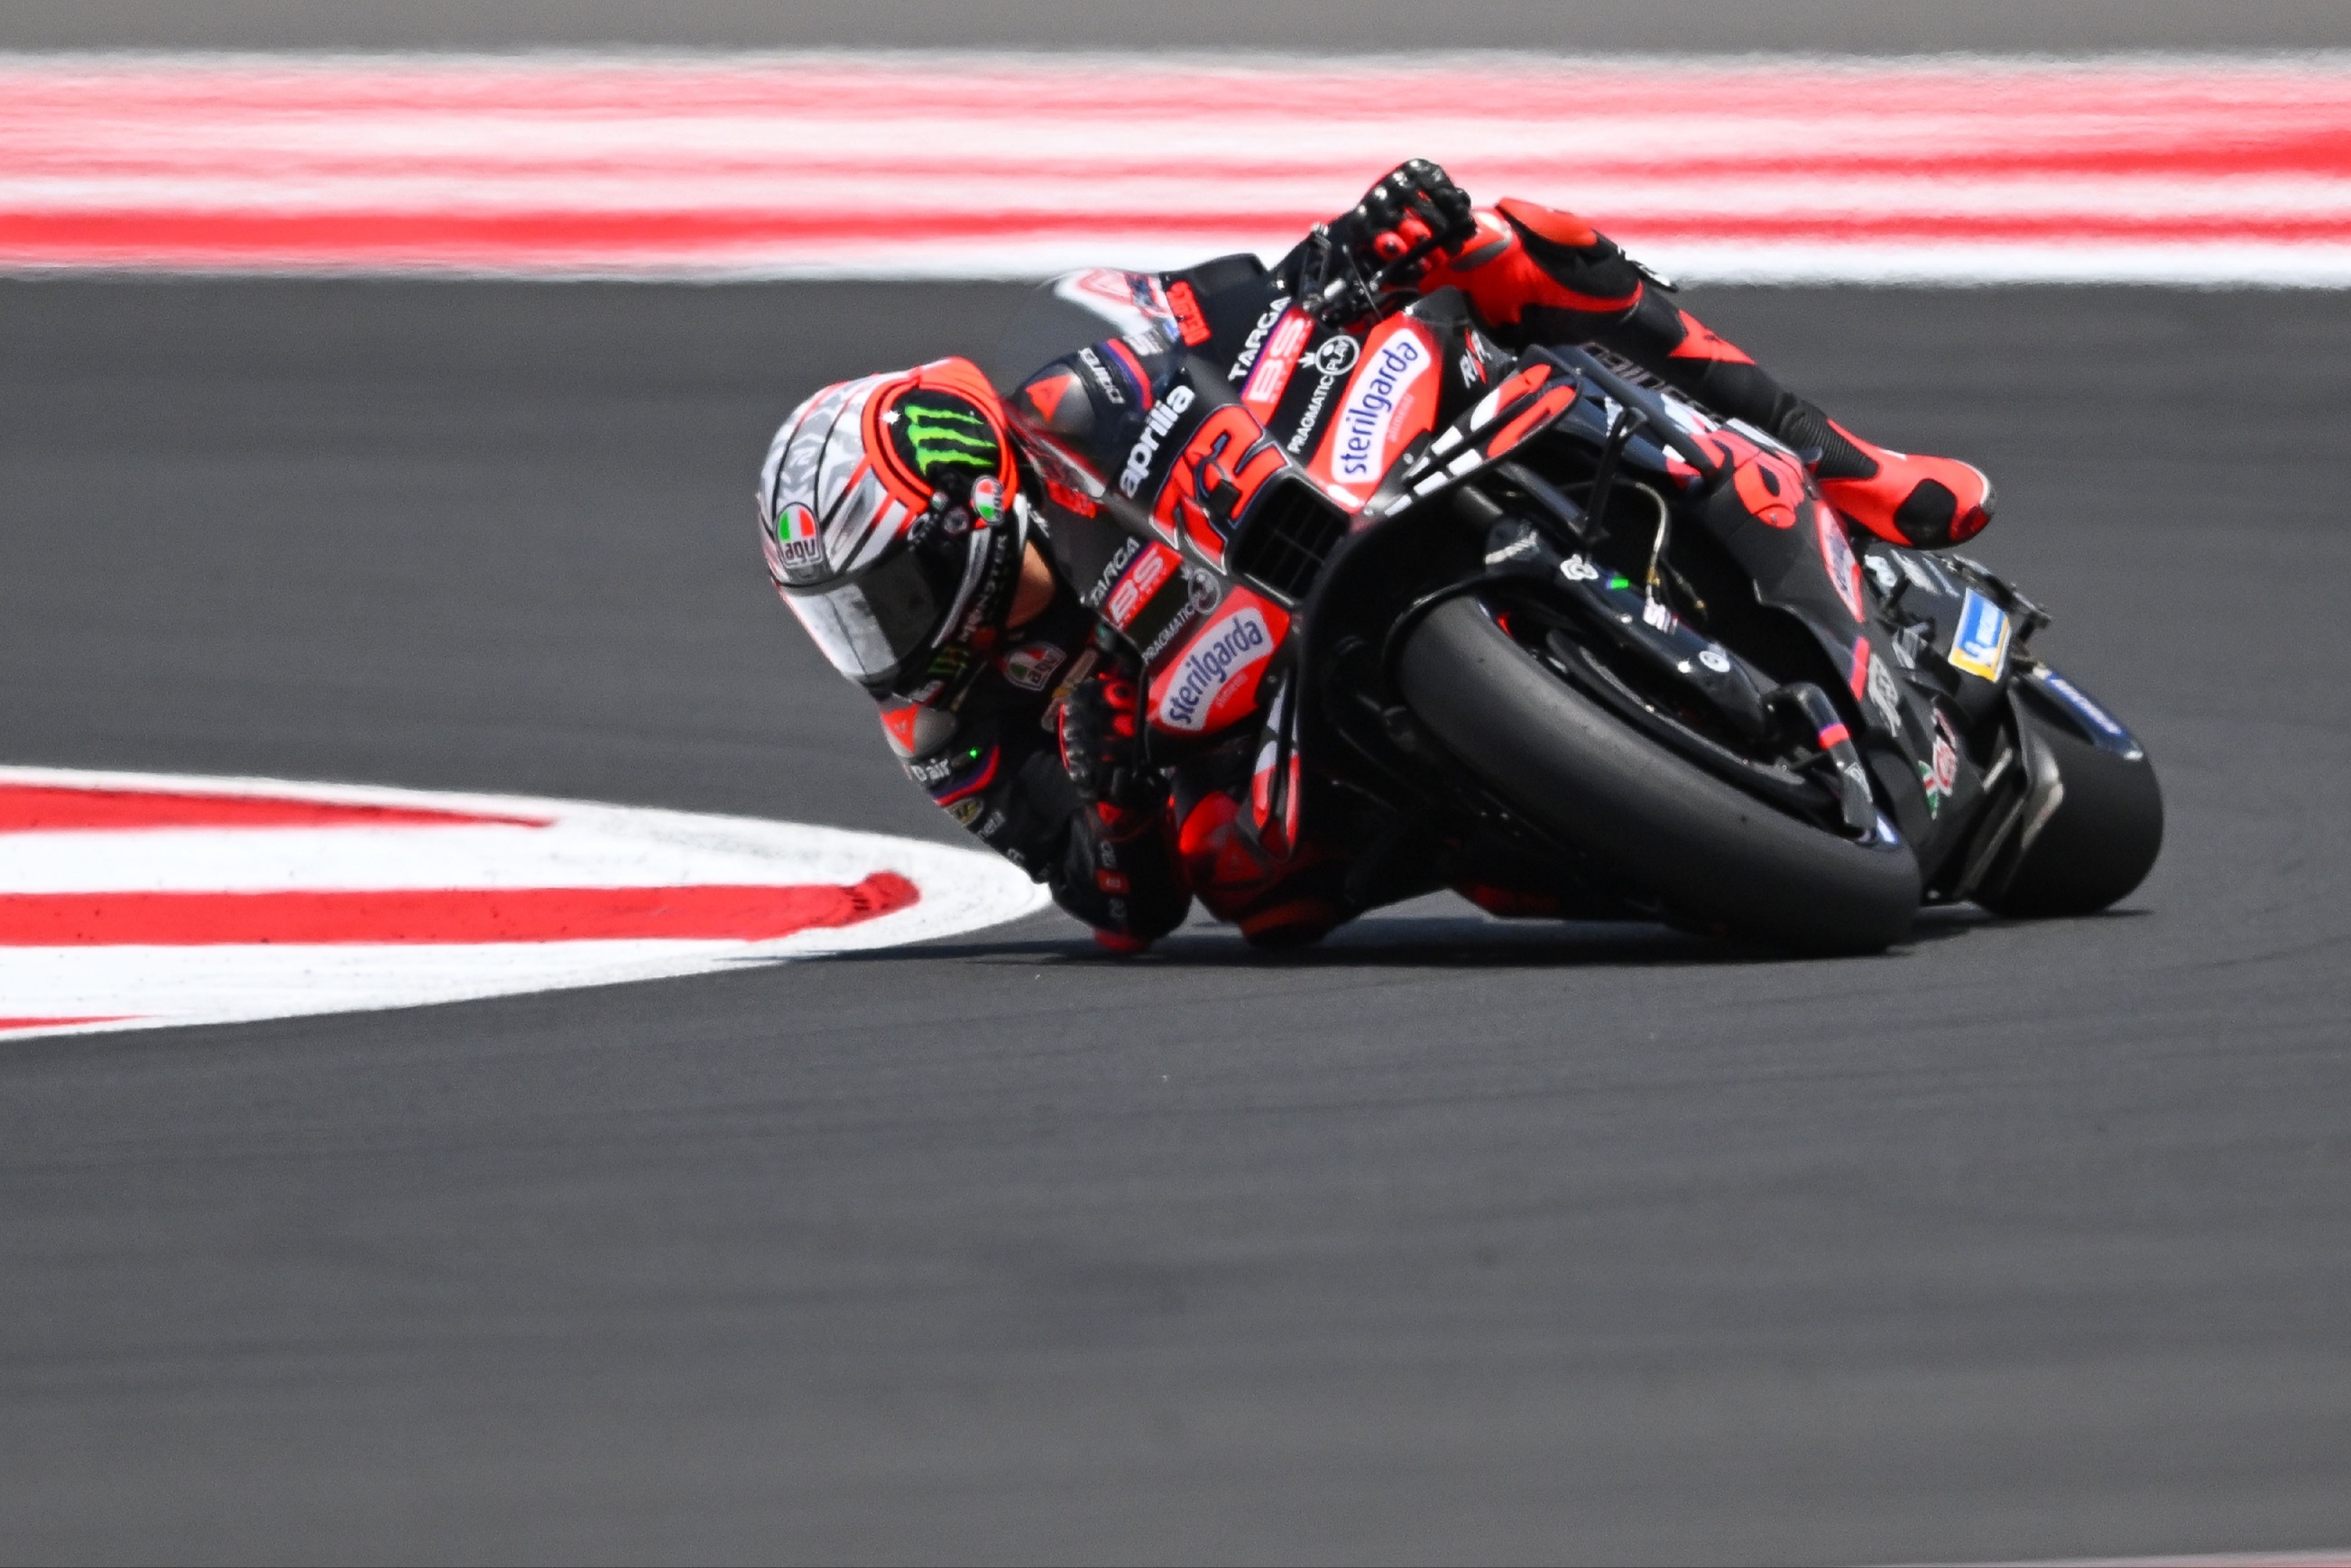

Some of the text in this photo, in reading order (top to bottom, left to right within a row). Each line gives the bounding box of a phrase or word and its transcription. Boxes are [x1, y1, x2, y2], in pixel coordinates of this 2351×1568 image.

[1228, 297, 1292, 383] TARGA
[1247, 317, 1306, 402] BS
[1119, 383, 1195, 499] aprilia
[1286, 374, 1335, 454] PRAGMATIC
[1340, 341, 1419, 475] sterilgarda
[1148, 403, 1292, 576] 72
[1089, 536, 1140, 606] TARGA
[1108, 545, 1165, 623] BS
[1141, 604, 1194, 666] PRAGMATIC
[1169, 617, 1264, 724] sterilgarda
